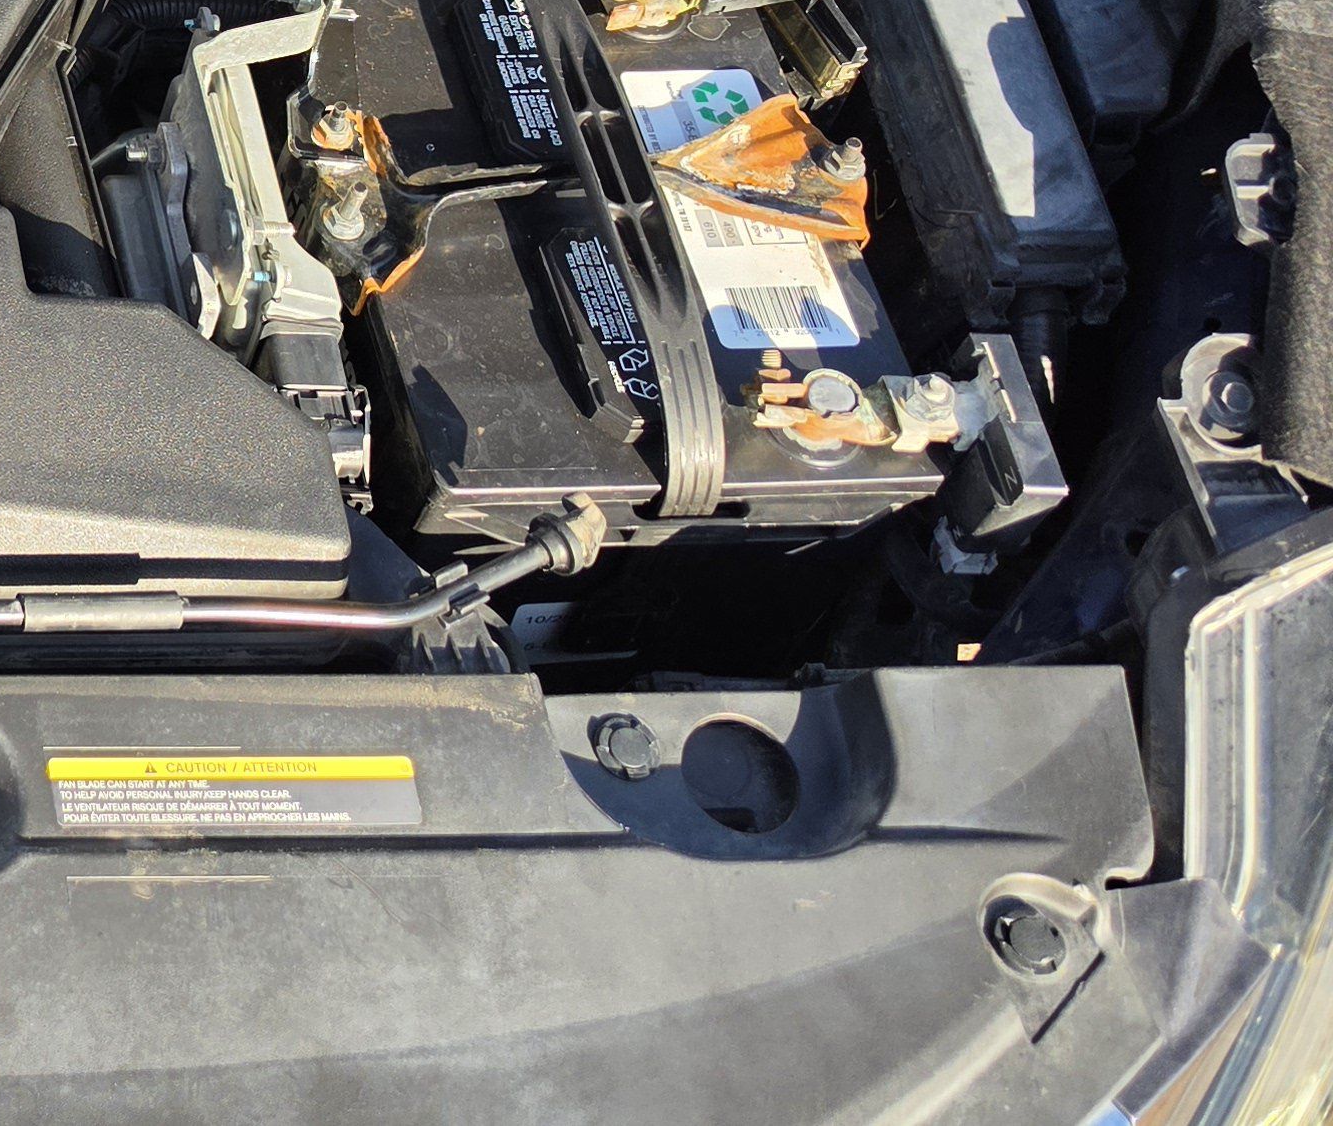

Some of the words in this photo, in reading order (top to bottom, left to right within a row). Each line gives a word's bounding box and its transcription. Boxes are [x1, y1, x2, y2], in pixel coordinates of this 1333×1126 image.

[498, 14, 513, 37] GASES
[526, 66, 538, 79] NO
[536, 94, 556, 127] SULFURIC
[549, 128, 563, 145] ACID
[703, 221, 717, 238] 610
[723, 221, 736, 238] 490
[607, 360, 625, 394] RECYCLE
[165, 761, 226, 773] CAUTION
[243, 761, 316, 772] ATTENTION
[58, 779, 76, 789] FAN
[76, 779, 106, 789] BLADE
[106, 779, 126, 789] CAN
[127, 779, 154, 789] START
[155, 779, 166, 789] AT
[167, 779, 186, 789] ANY
[59, 790, 72, 800] TO
[73, 790, 96, 800] HELP
[97, 790, 125, 800] AVOID
[125, 789, 173, 800] PERSONAL
[227, 789, 259, 799] HANDS
[61, 802, 73, 812] LE
[73, 802, 131, 812] VENTILATEUR
[131, 801, 165, 812] RISQUE
[165, 801, 179, 812] DE
[179, 801, 228, 812] DÉMARRER
[236, 801, 260, 813] TOUT
[63, 810, 89, 823] POUR
[90, 810, 120, 823] ÉVITER
[120, 810, 150, 823] TOUTE
[199, 812, 213, 823] NE
[213, 812, 232, 823] PAS
[232, 812, 246, 823] EN
[246, 812, 302, 822] APPROCHER
[302, 811, 320, 824] LES
